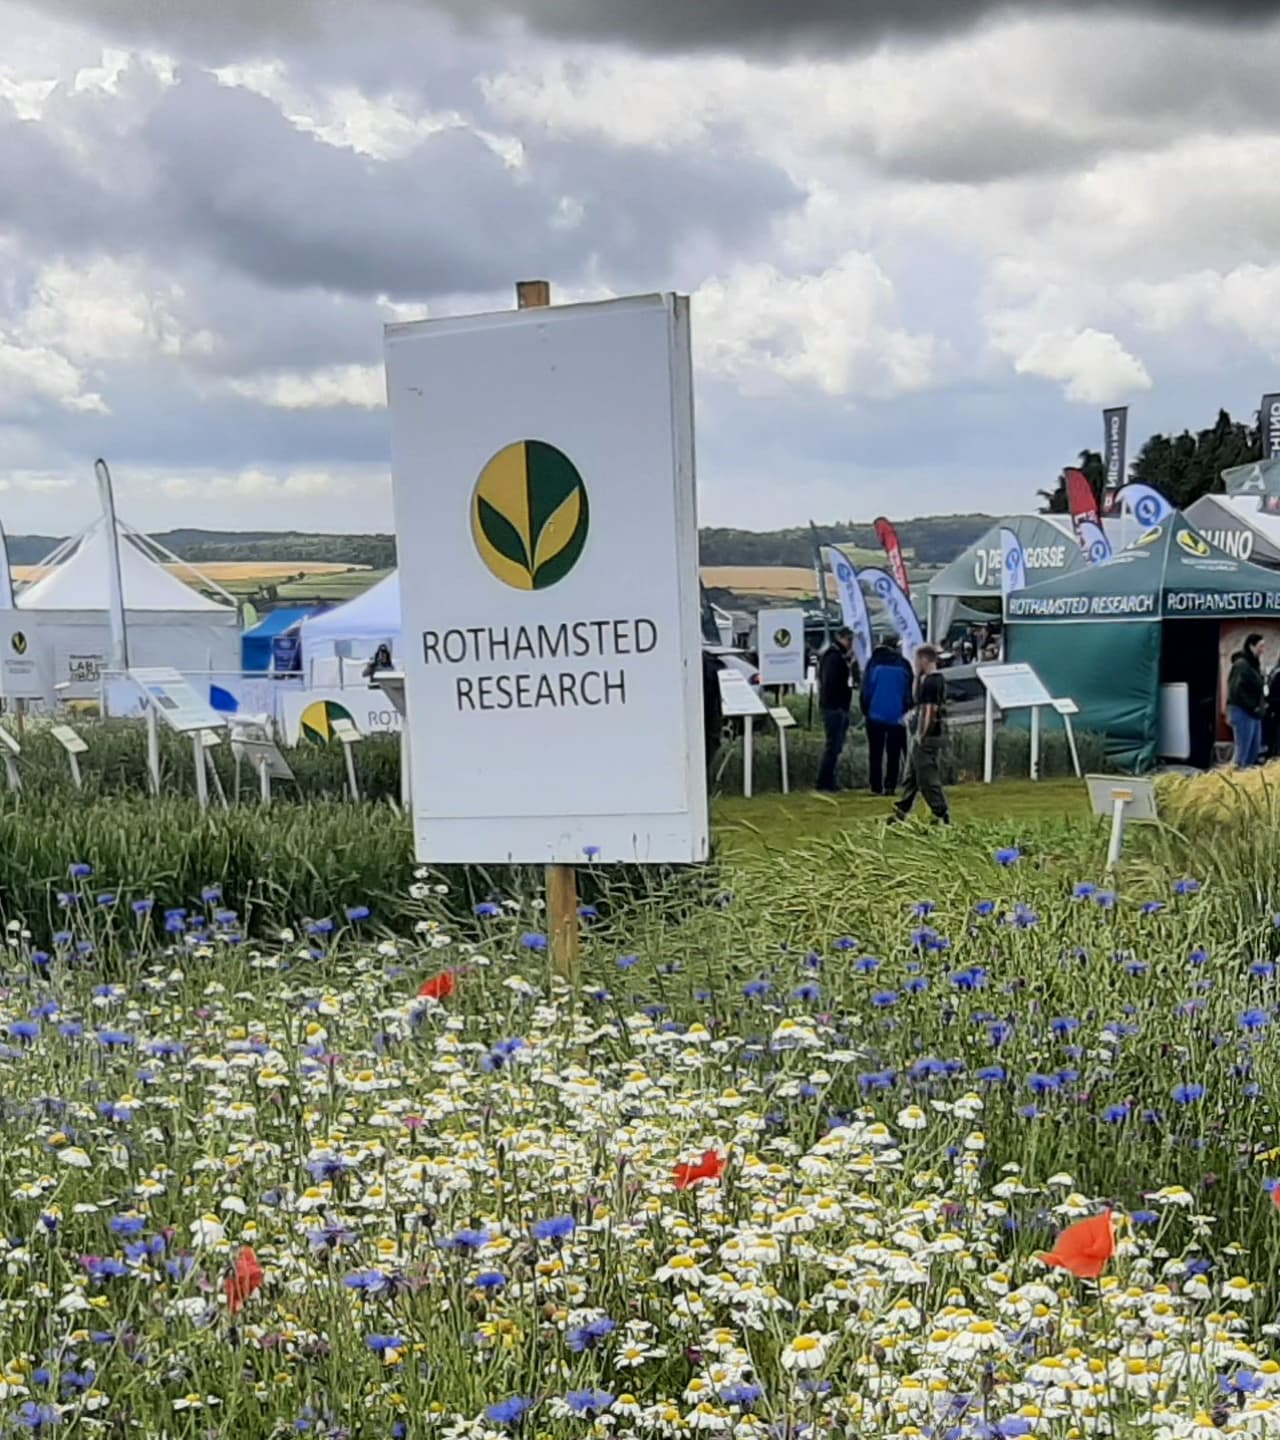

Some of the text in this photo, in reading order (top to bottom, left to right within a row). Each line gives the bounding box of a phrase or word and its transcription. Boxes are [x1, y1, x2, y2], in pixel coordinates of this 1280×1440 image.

[1024, 546, 1066, 568] GOSSE
[1200, 530, 1253, 560] HINO
[1009, 594, 1154, 615] ROTHAMSTED RESEARCH
[1167, 592, 1263, 610] ROTHAMSTED
[422, 618, 658, 664] ROTHAMSTED
[456, 669, 626, 711] RESEARCH
